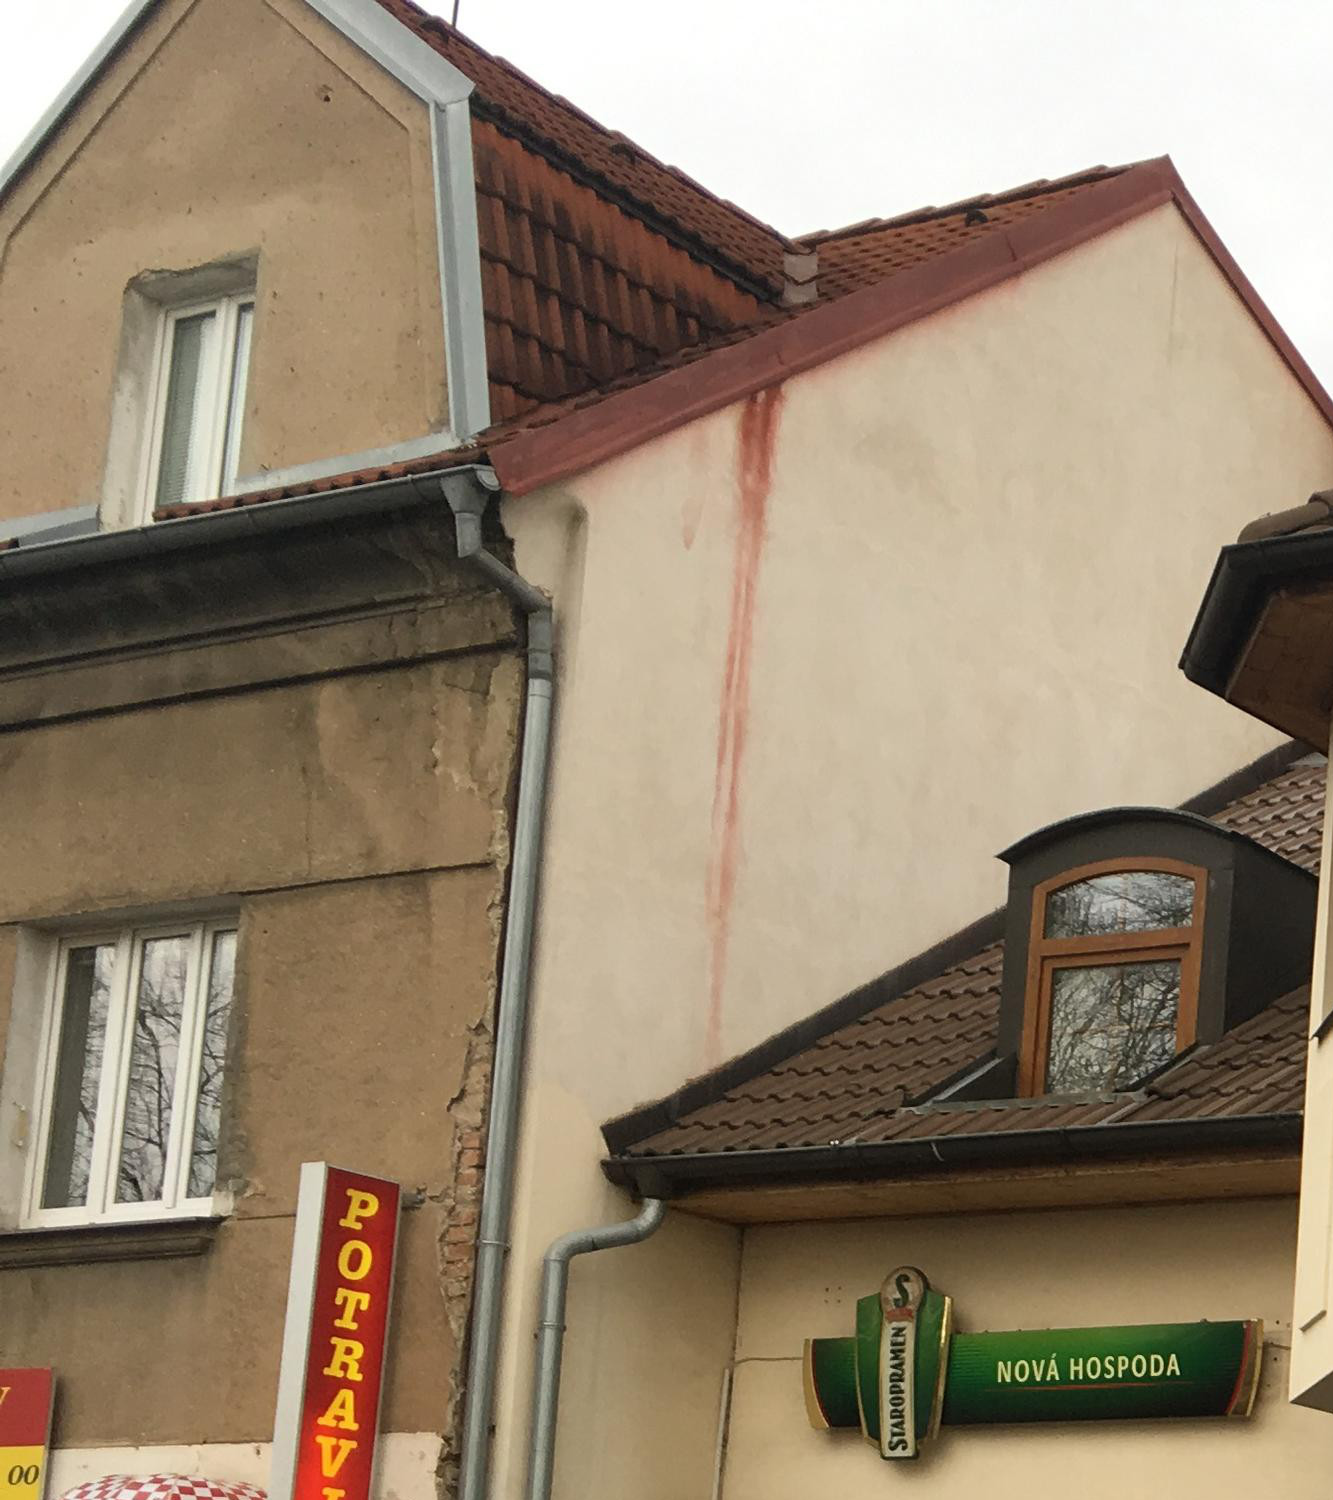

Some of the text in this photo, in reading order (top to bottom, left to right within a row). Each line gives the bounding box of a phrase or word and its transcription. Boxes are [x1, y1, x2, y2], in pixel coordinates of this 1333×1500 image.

[888, 1326, 908, 1452] STAROPRAMEN
[997, 1353, 1181, 1383] NOVÁ HOSPODA
